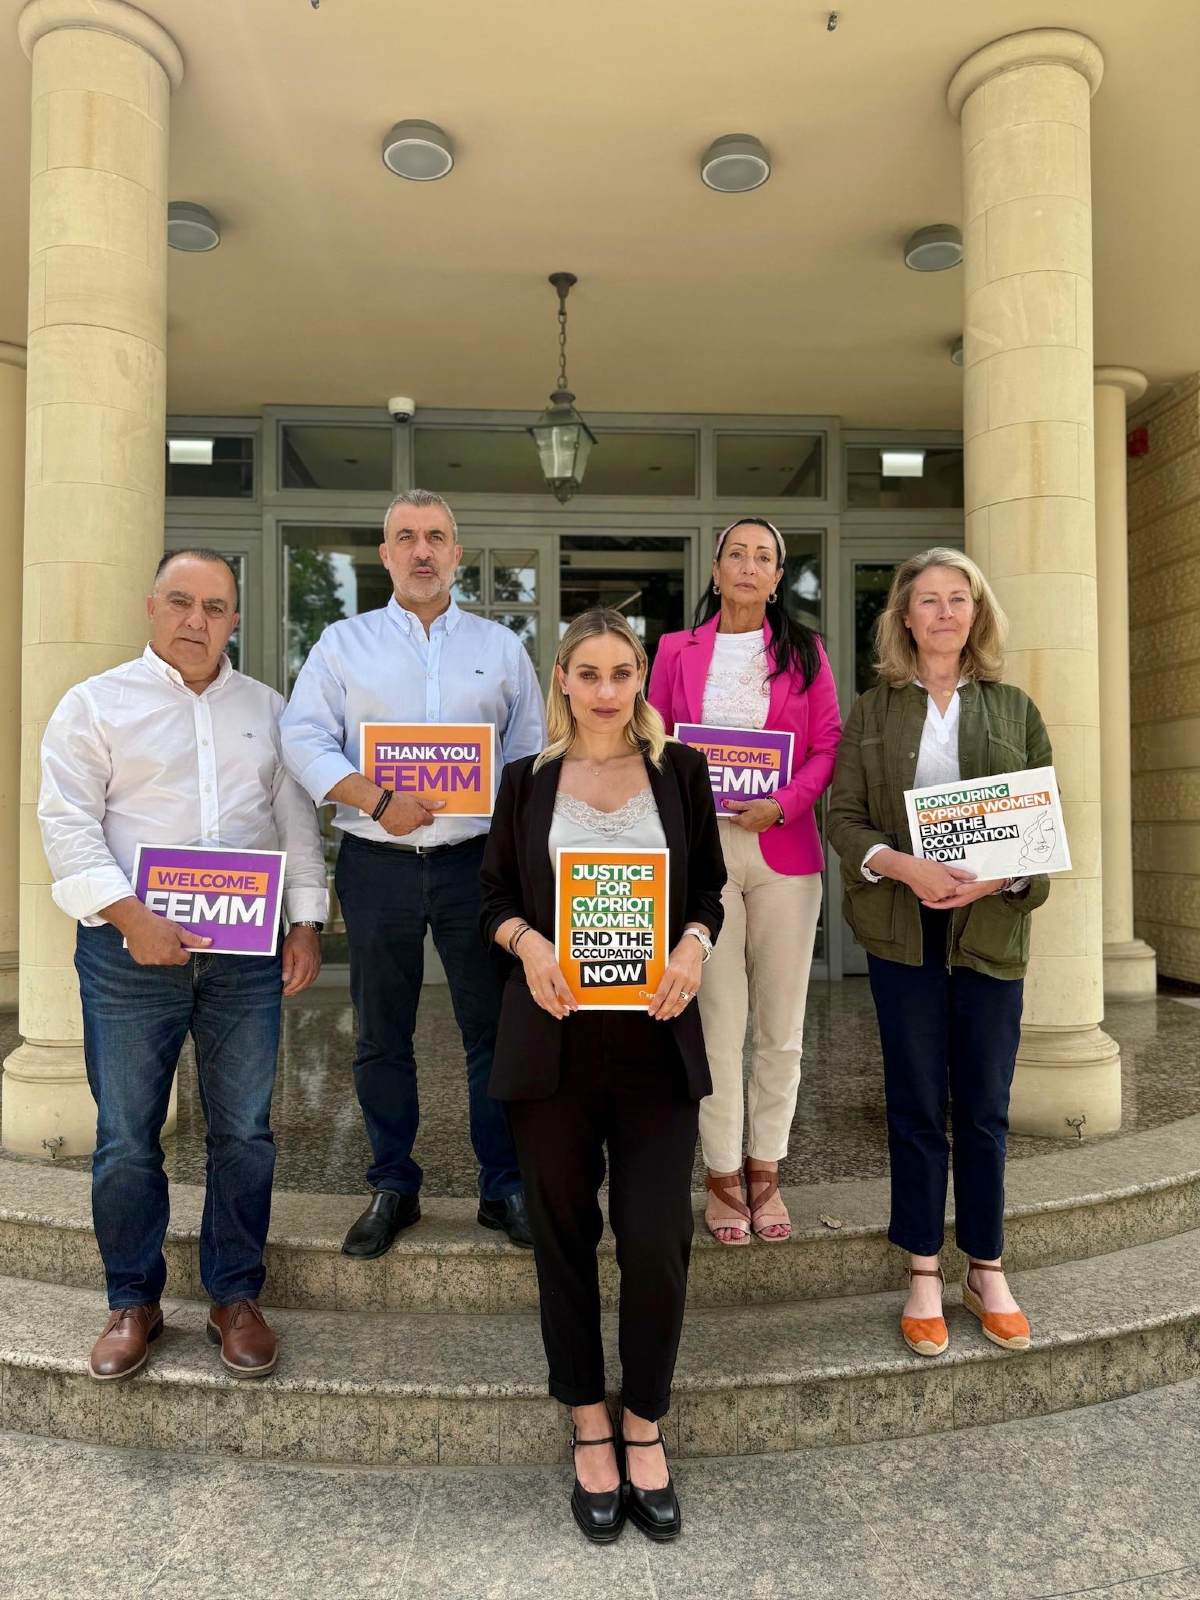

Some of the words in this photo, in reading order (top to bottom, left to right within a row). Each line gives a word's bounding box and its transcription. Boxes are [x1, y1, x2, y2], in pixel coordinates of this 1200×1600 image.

[377, 746, 437, 760] THANK
[440, 746, 479, 763] YOU,
[375, 765, 481, 792] FEMM
[709, 766, 780, 794] EMM
[917, 784, 1008, 810] HONOURING
[918, 804, 981, 823] CYPRIOT
[981, 793, 1050, 815] WOMEN,
[921, 822, 953, 836] END
[955, 816, 984, 831] THE
[922, 826, 1018, 849] OCCUPATION
[924, 847, 964, 862] NOW
[157, 871, 260, 892] WELCOME,
[572, 864, 654, 880] JUSTICE
[596, 881, 631, 896] FOR
[145, 890, 266, 926] FEMM
[572, 897, 654, 912] CYPRIOT
[572, 913, 653, 930] WOMEN,
[572, 931, 613, 946] END
[615, 932, 653, 946] THE
[572, 948, 653, 959] OCCUPATION
[583, 963, 642, 984] NOW
